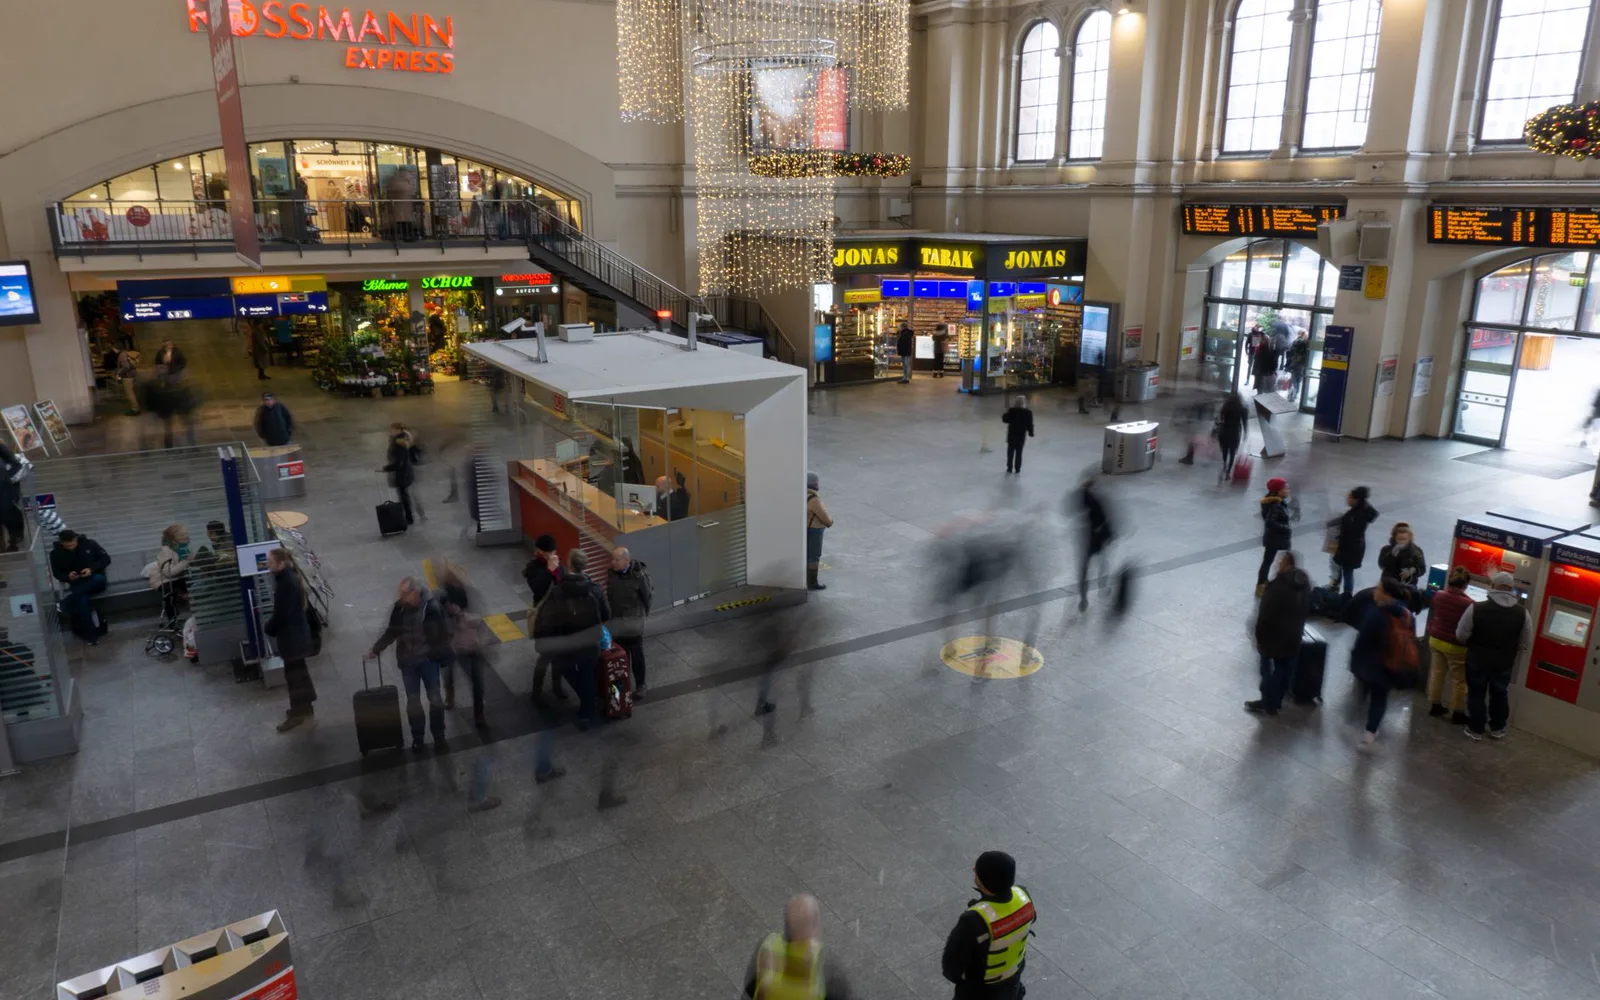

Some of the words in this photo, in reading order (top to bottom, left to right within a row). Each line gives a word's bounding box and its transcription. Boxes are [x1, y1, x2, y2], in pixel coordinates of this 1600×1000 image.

[345, 46, 454, 73] EXPRESS
[316, 158, 349, 166] SCHÖNHEIT
[833, 247, 898, 267] JONAS
[920, 247, 974, 269] TABAK
[1004, 249, 1066, 269] JONAS
[421, 275, 473, 289] SCHOR
[1461, 525, 1499, 539] Fahrkarten
[1556, 548, 1599, 564] Fahrkarten
